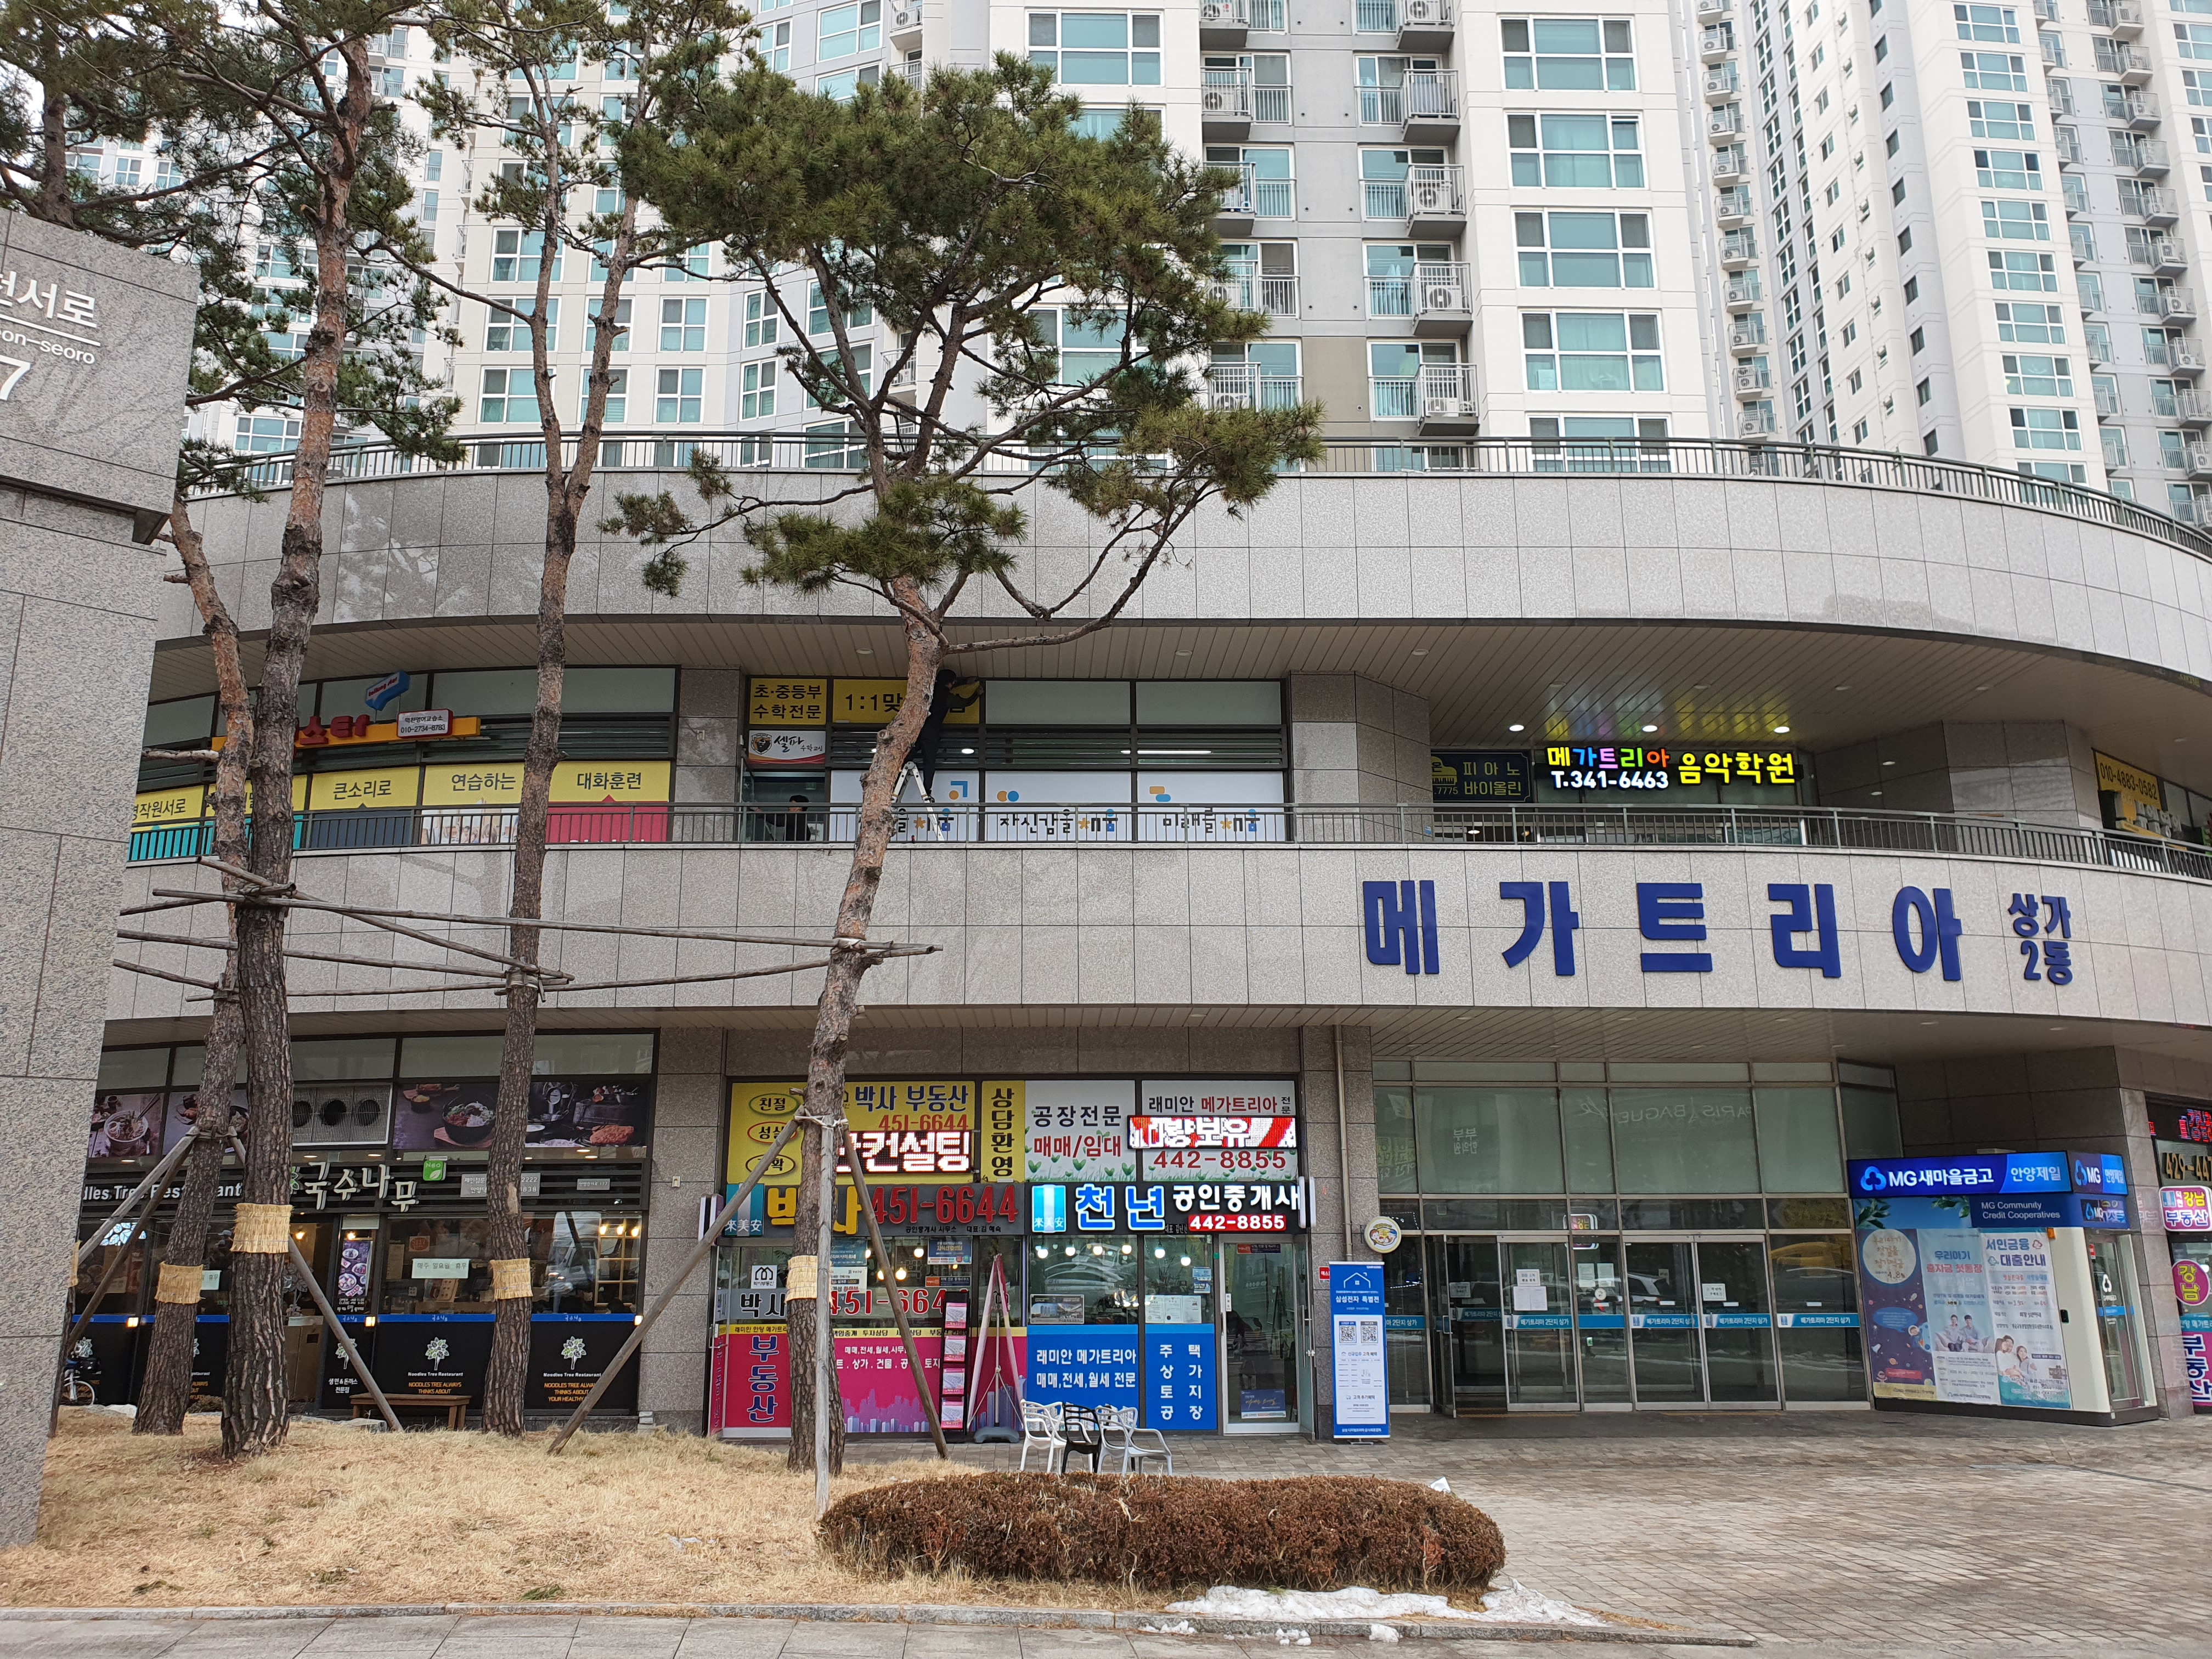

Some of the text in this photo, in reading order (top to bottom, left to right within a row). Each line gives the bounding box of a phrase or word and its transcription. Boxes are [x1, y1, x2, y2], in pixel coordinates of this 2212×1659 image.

[753, 704, 822, 719] 수학전문
[400, 724, 446, 733] 010-2734-8783
[1547, 747, 1796, 784] 메가트리아 음악학원
[451, 773, 516, 792] 연습하는
[577, 772, 642, 791] 대화훈련
[1464, 781, 1522, 795] 바이올린
[1551, 770, 1669, 789] T.341-6463
[333, 780, 392, 800] 큰소리로
[2007, 892, 2071, 939] 상가
[1362, 879, 1962, 981] 메가트리아
[2021, 939, 2073, 985] 2동
[759, 1098, 786, 1111] 친절
[855, 1085, 969, 1112] 박사 부동산
[1148, 1096, 1194, 1113] 래미안
[1201, 1096, 1278, 1113] 메가트리아
[878, 1114, 969, 1131] 451-6644
[1032, 1105, 1122, 1127] 공장전문
[990, 1087, 1015, 1177] 상담환영
[1034, 1135, 1121, 1158] 매매/임대
[1153, 1151, 1286, 1169] 442-8855
[2010, 1166, 2062, 1181] 안양제일
[2086, 1166, 2125, 1184] MG 안양제일
[305, 1162, 419, 1212] 국수나무
[873, 1185, 1019, 1224] 451-6644
[1076, 1183, 1300, 1231] 천년 공인중개사
[1996, 1201, 2042, 1212] Community
[2183, 1191, 2205, 1207] 강남
[1190, 1216, 1285, 1231] 442-8855
[1983, 1210, 2061, 1220] Credit Cooperatives
[2166, 1210, 2209, 1227] 부동산
[1985, 1238, 2030, 1251] 서민금융
[2000, 1254, 2047, 1267] 대출안내
[2178, 1264, 2201, 1301] 강남
[1335, 1295, 1359, 1304] 삼성전자
[1036, 1348, 1137, 1365] 래미안 메가트리아
[746, 1335, 779, 1423] 부동산
[1036, 1372, 1136, 1389] 매매,전세,월세 전문
